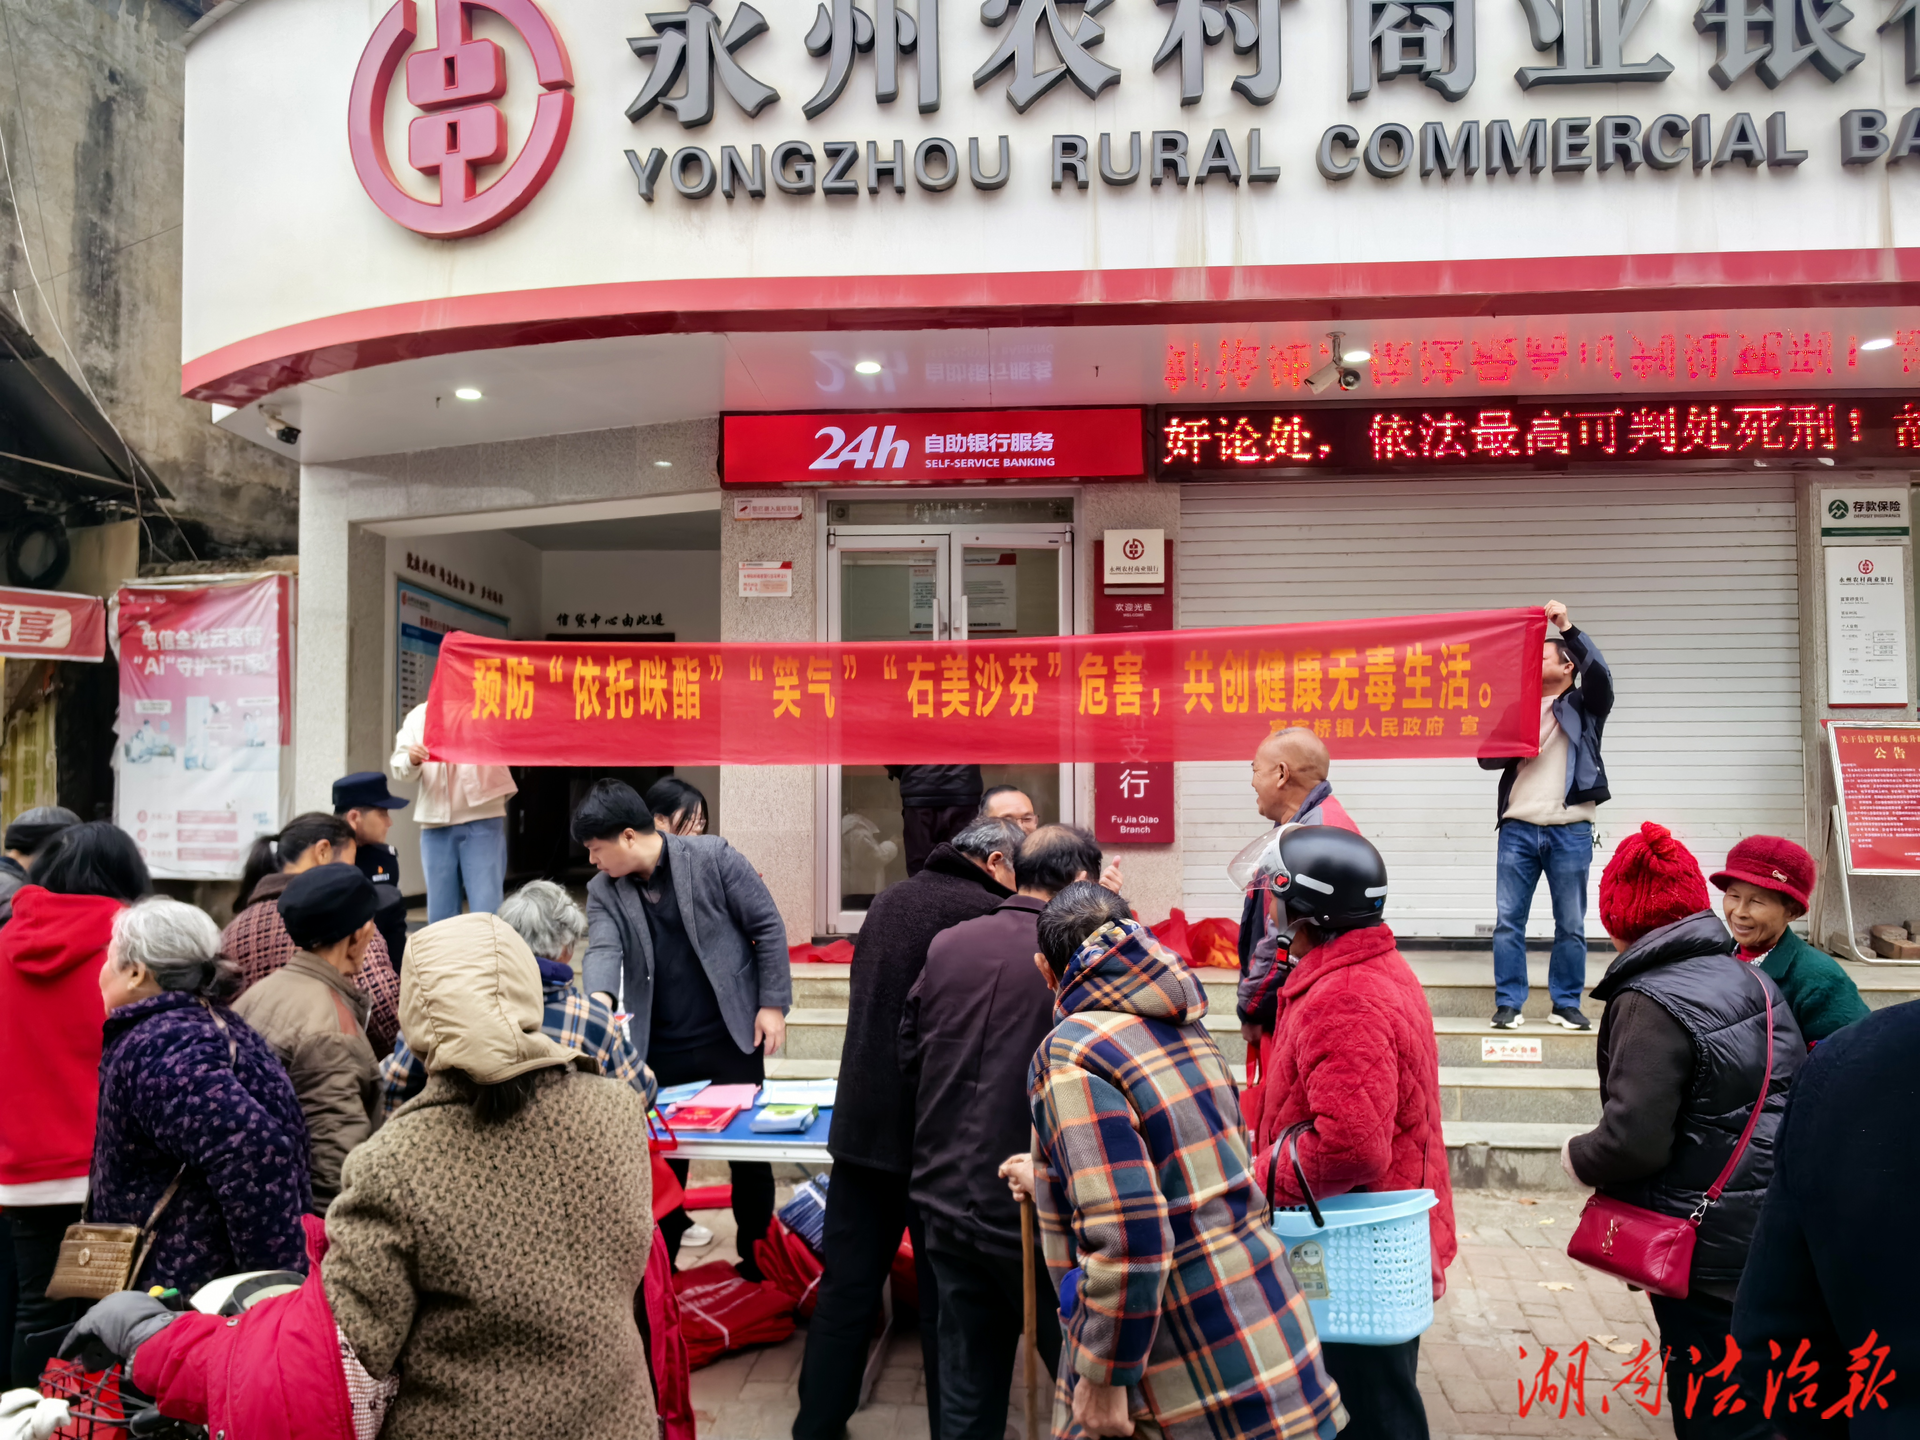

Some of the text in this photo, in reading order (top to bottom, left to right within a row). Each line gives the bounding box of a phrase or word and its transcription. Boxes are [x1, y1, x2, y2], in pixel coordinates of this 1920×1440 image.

[624, 134, 1010, 202] YONGZHOU
[1051, 128, 1281, 191] RURAL
[1316, 111, 1808, 181] COMMERCIAL
[808, 425, 910, 470] 24h
[925, 432, 1054, 453] 自助银行服务
[925, 457, 1055, 468] SELF-SERVICE BANKING
[1853, 501, 1901, 512] 存款保险
[1115, 603, 1152, 611] 欢迎光临
[1460, 715, 1480, 736] 宣
[1874, 746, 1906, 759] 公告
[1111, 815, 1122, 823] Fu
[1139, 815, 1159, 823] Qiao
